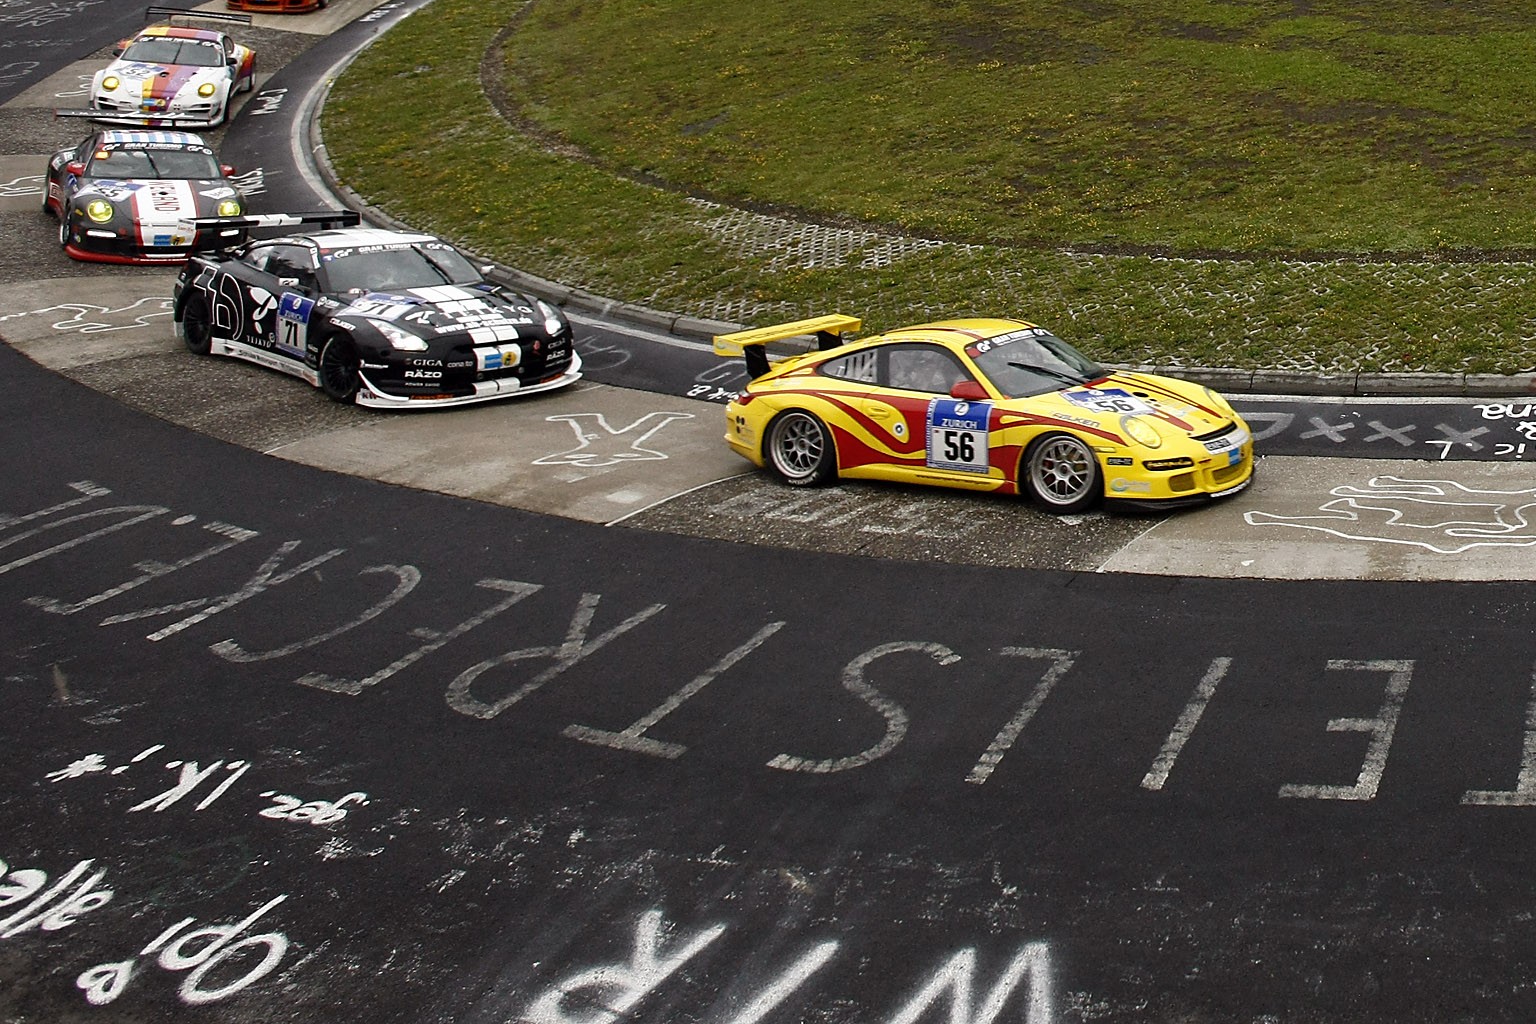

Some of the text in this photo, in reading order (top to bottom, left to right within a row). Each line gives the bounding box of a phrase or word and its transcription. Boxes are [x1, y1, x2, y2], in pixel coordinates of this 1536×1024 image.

[358, 244, 383, 253] GRAN
[364, 303, 394, 315] 71
[284, 322, 298, 347] 71
[413, 359, 443, 367] GIGA
[405, 369, 442, 378] RÄZO
[1094, 398, 1134, 413] 56
[941, 418, 977, 429] ZURICH
[944, 430, 975, 463] 56
[138, 893, 289, 1005] Opi
